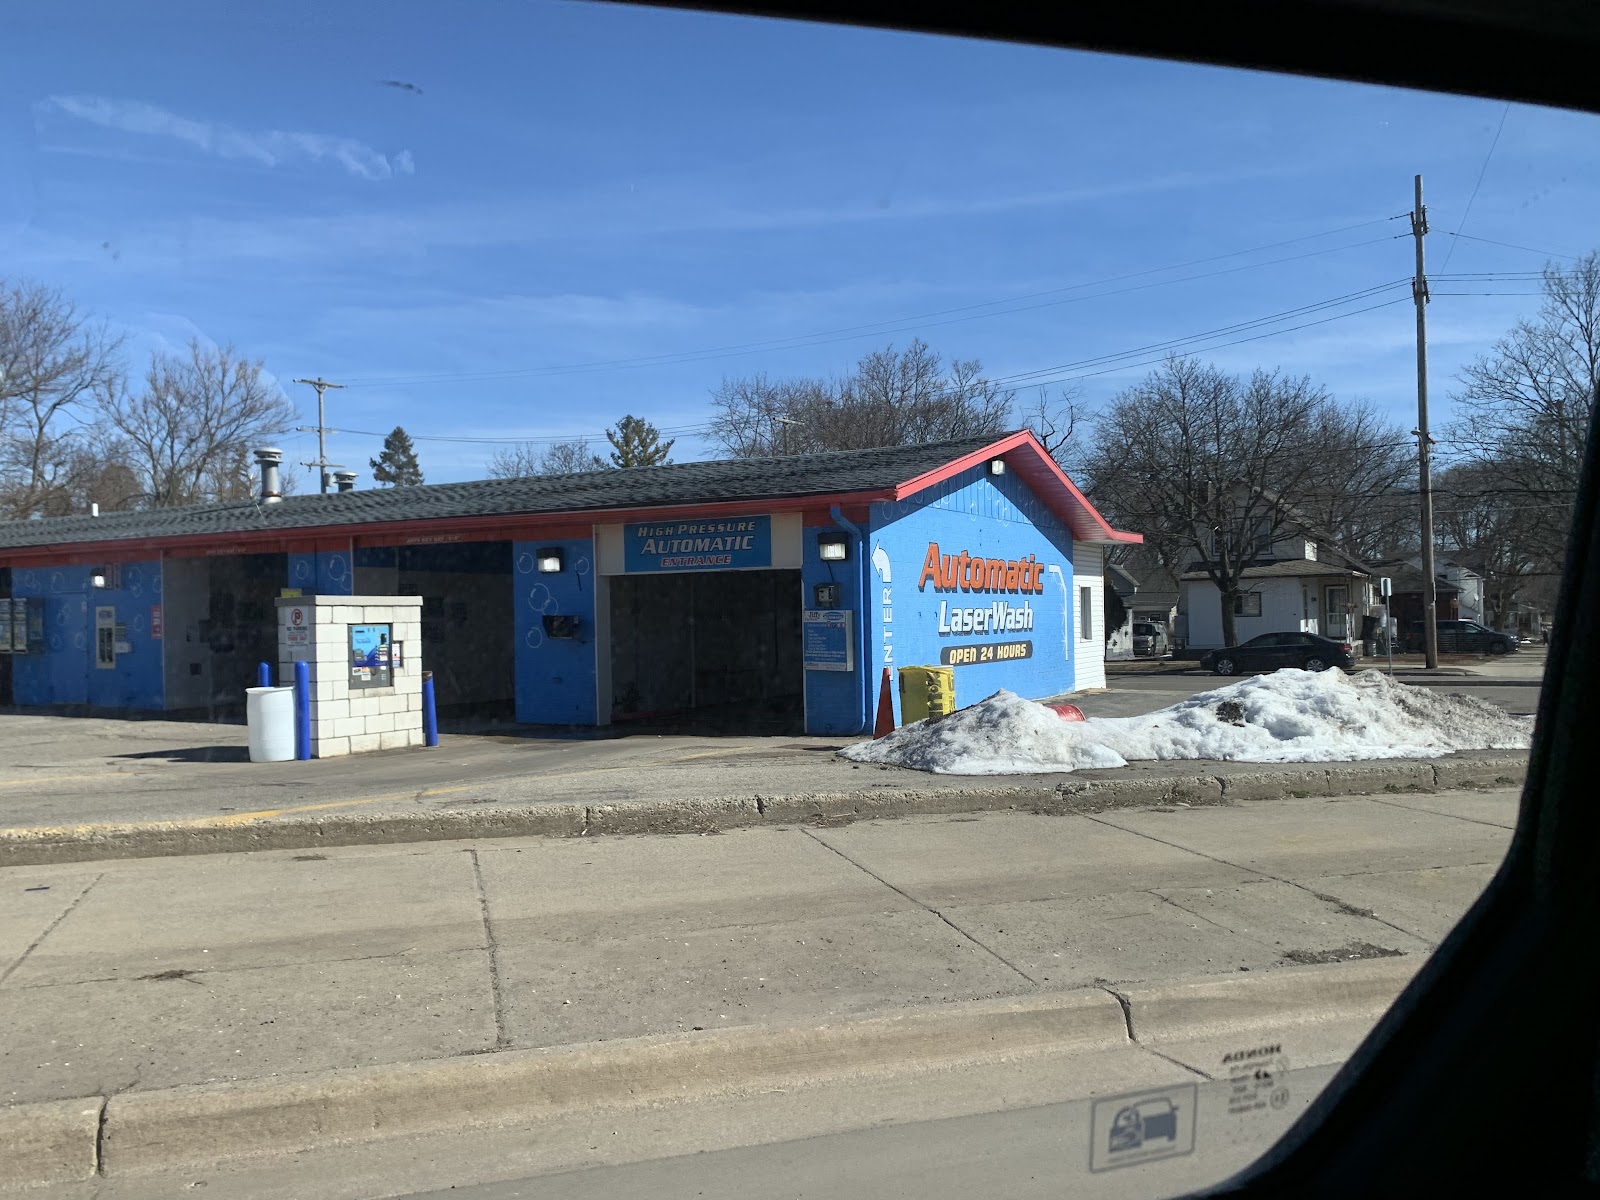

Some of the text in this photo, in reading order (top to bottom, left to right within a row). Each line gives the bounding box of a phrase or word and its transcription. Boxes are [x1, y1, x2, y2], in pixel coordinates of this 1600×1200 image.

[638, 522, 756, 537] HIGH PRESSURE
[641, 536, 754, 555] AUTOMATIC
[662, 555, 731, 567] ENTRANCE
[918, 542, 1045, 595] Automatic
[938, 599, 1034, 637] LaserWash
[949, 643, 1027, 665] OPEN 24 HOURS
